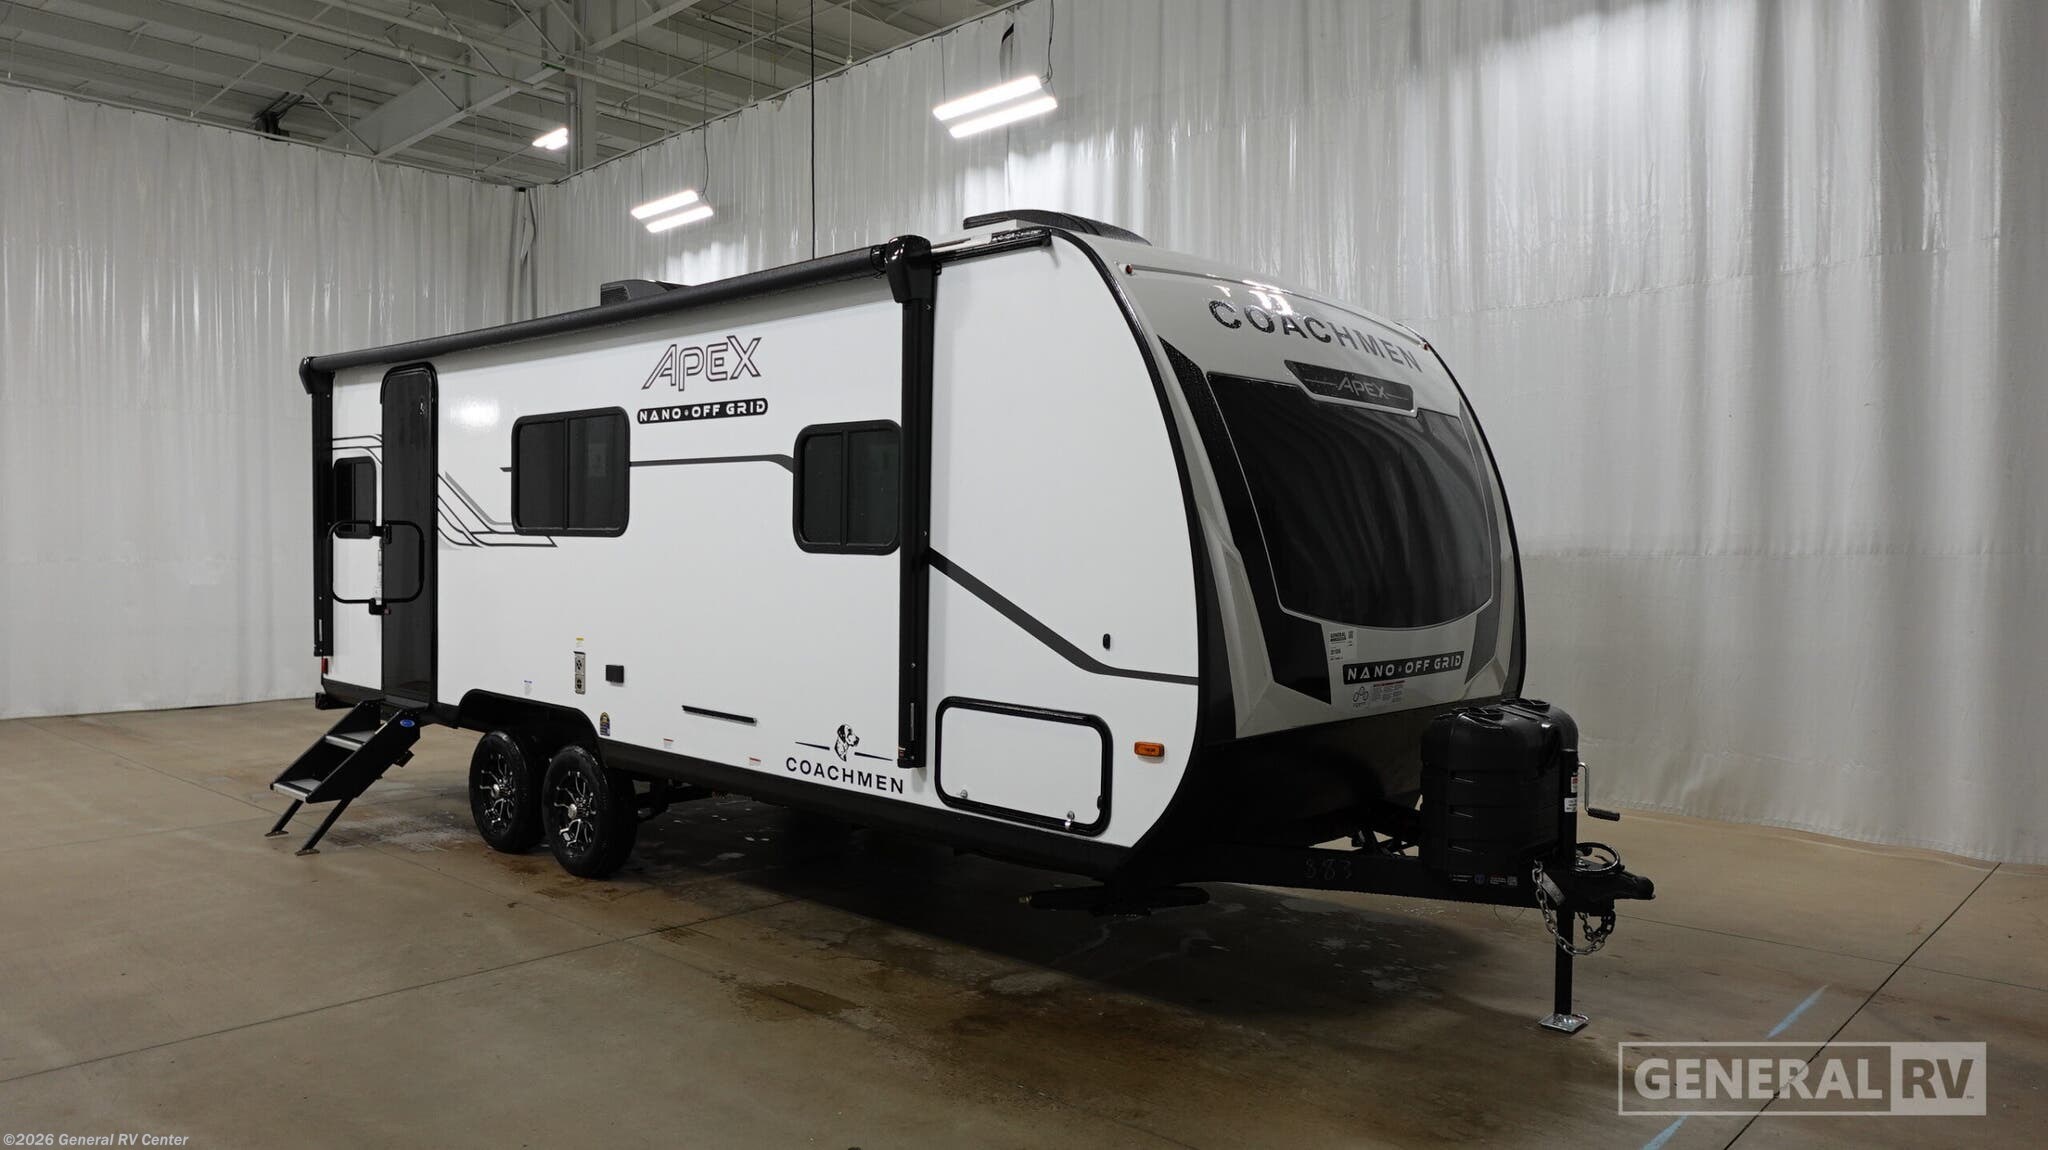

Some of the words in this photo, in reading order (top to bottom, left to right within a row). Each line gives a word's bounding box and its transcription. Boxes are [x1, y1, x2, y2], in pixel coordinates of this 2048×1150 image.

[1208, 300, 1423, 372] COACHMEN
[641, 335, 762, 391] APEX
[1337, 376, 1387, 400] APEX
[639, 408, 681, 422] NANO
[691, 404, 721, 418] OFF
[726, 400, 766, 415] GRID
[1347, 664, 1395, 681] NANO
[1405, 659, 1431, 674] OFF
[1434, 655, 1462, 670] GRID
[786, 757, 903, 794] COACHMEN
